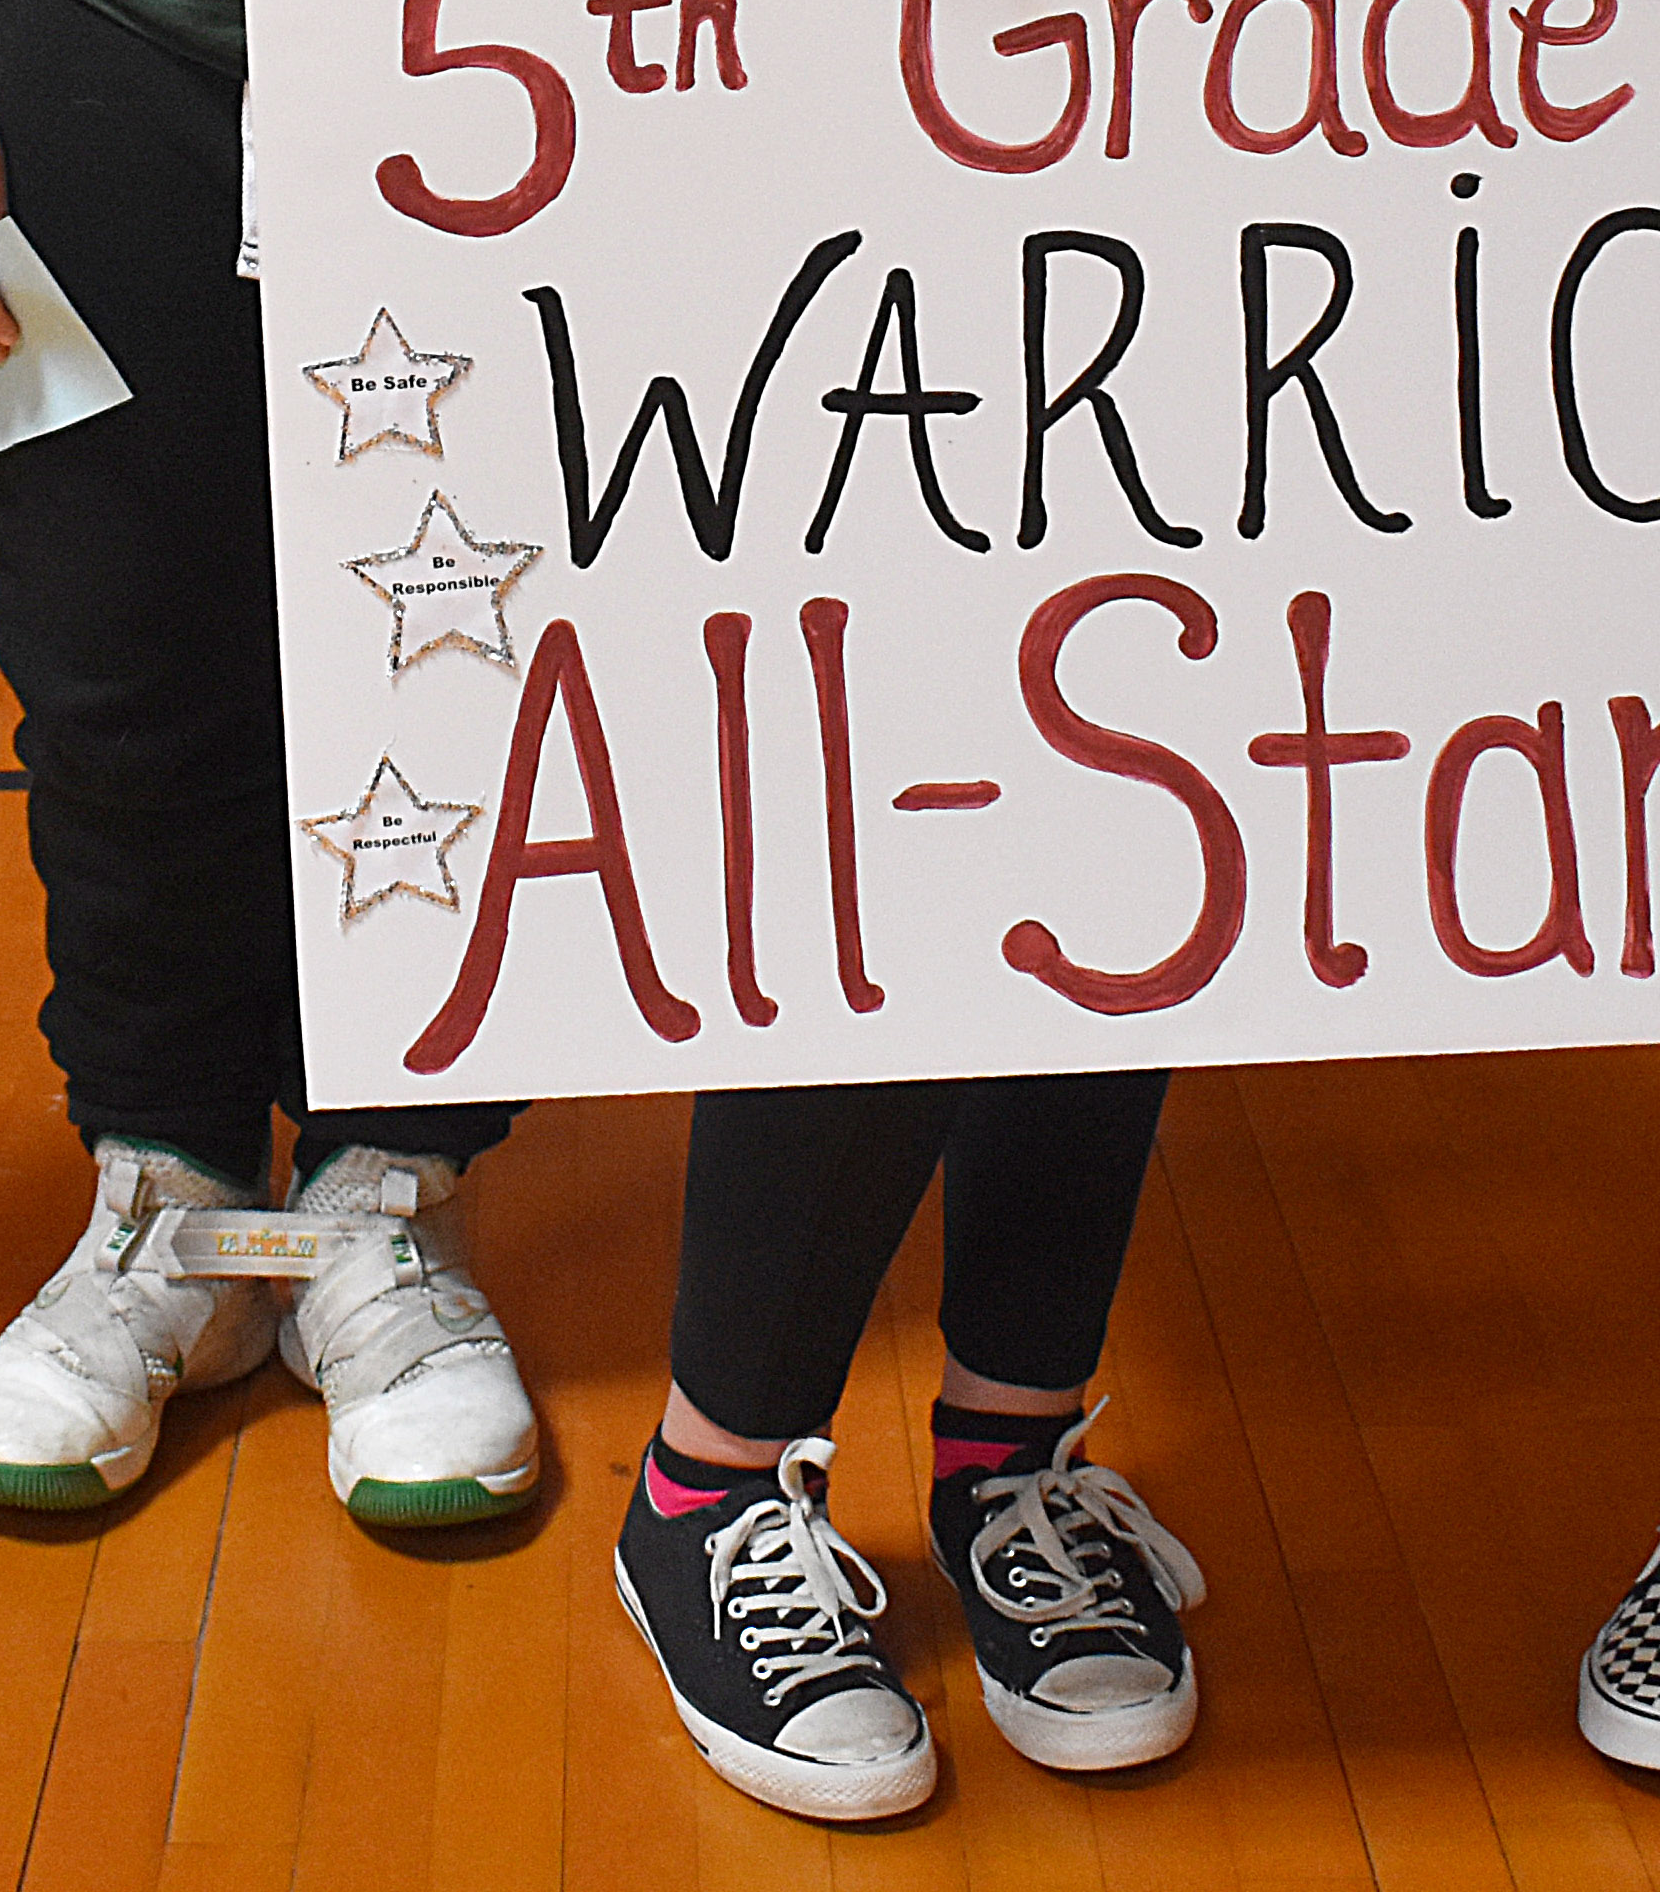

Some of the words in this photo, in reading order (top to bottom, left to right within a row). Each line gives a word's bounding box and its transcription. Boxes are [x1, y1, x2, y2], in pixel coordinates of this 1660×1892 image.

[351, 377, 377, 392] Be
[383, 374, 428, 391] Safe
[432, 555, 456, 570] Be
[392, 574, 500, 596] Responsible
[382, 815, 403, 828] Be
[353, 830, 438, 851] Respectful
